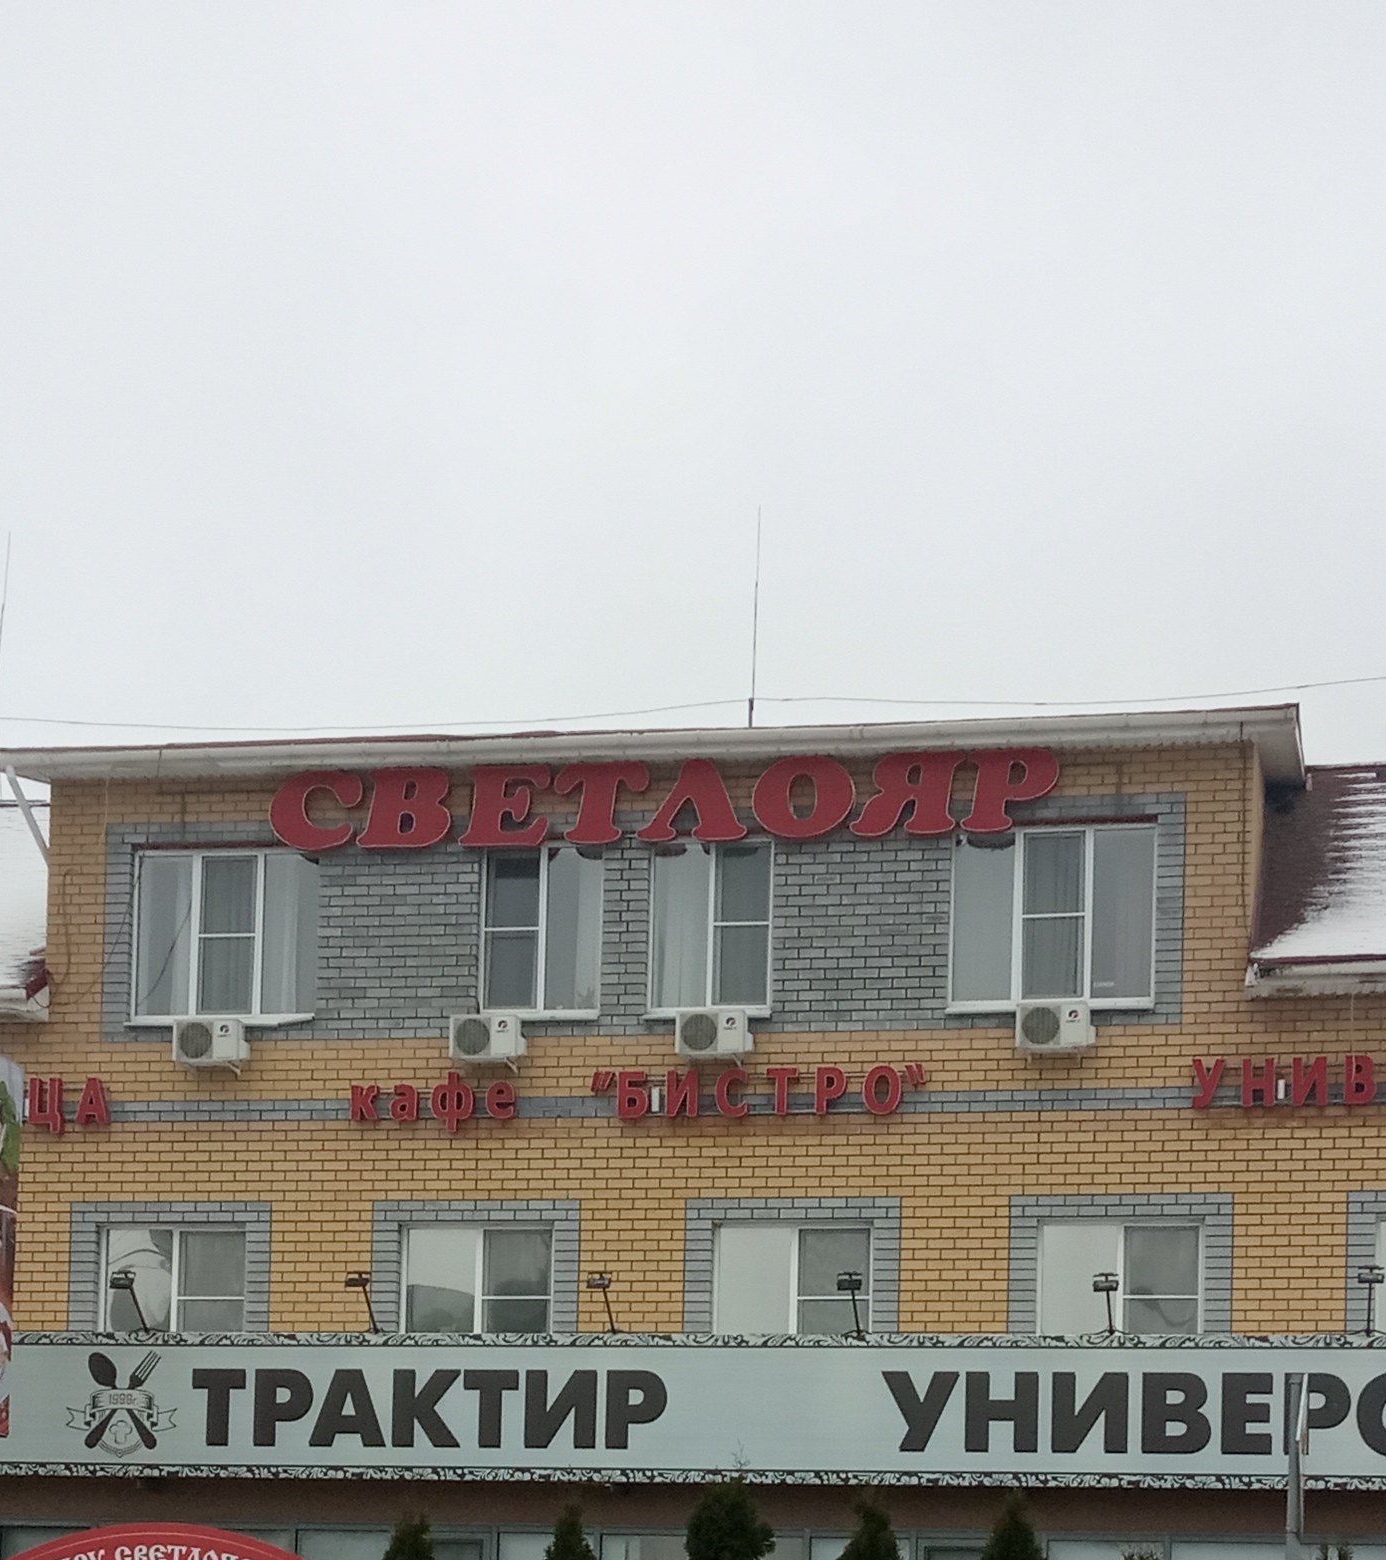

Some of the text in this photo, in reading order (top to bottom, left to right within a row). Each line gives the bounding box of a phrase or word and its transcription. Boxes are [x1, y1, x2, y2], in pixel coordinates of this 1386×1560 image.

[268, 746, 1060, 851] СВЕТЛОЯР
[349, 1063, 927, 1134] кафе "БИСТРО"
[191, 1368, 668, 1450] ТРАКТИР
